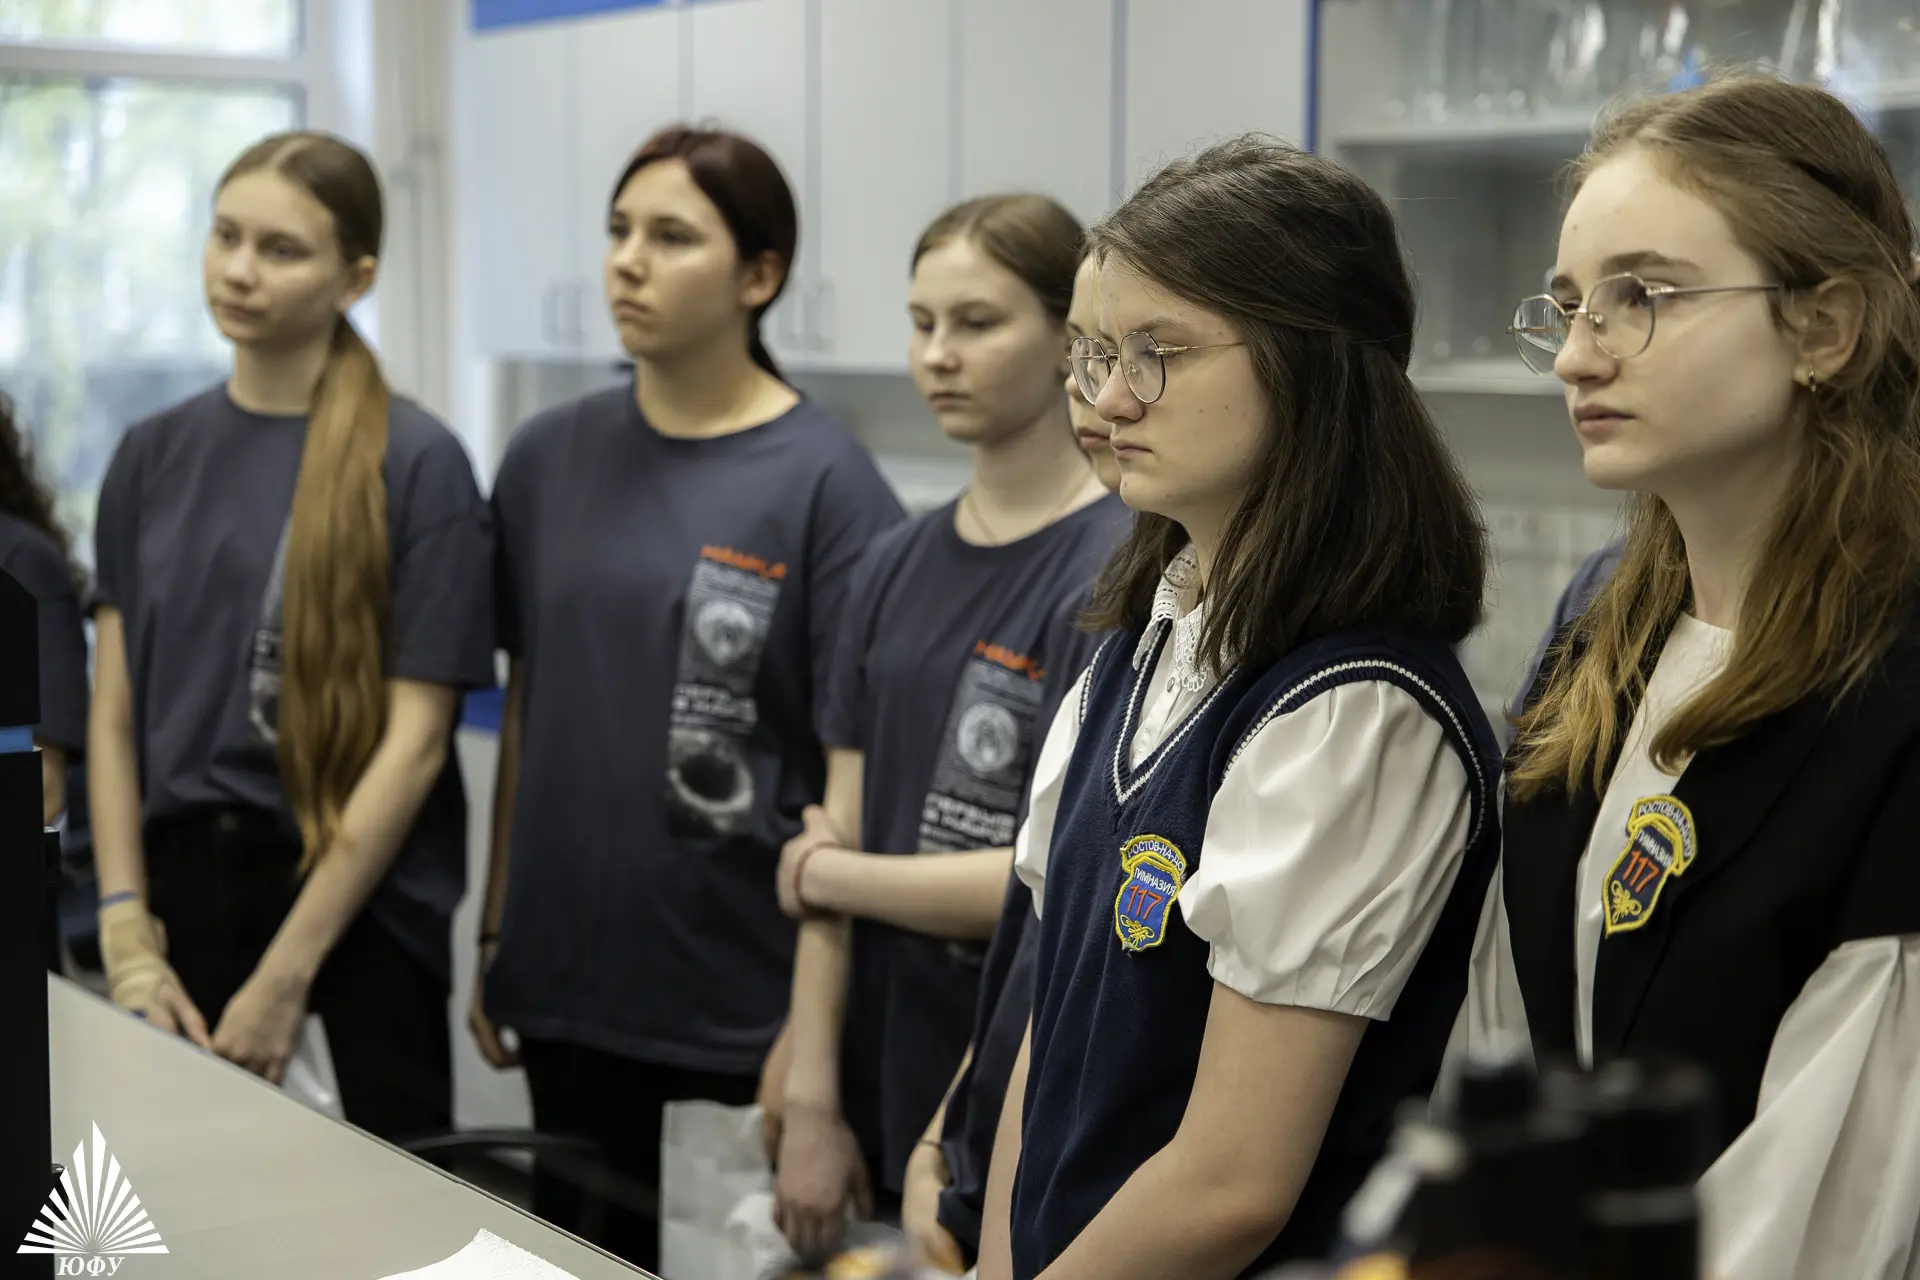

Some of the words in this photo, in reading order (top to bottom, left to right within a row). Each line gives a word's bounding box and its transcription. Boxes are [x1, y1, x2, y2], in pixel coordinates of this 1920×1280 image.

[1128, 840, 1184, 871] РОСТОВ-НА-ДО
[1622, 850, 1660, 893] 117
[1134, 867, 1177, 897] ГИМНАЗИЯ
[1127, 884, 1163, 920] 117
